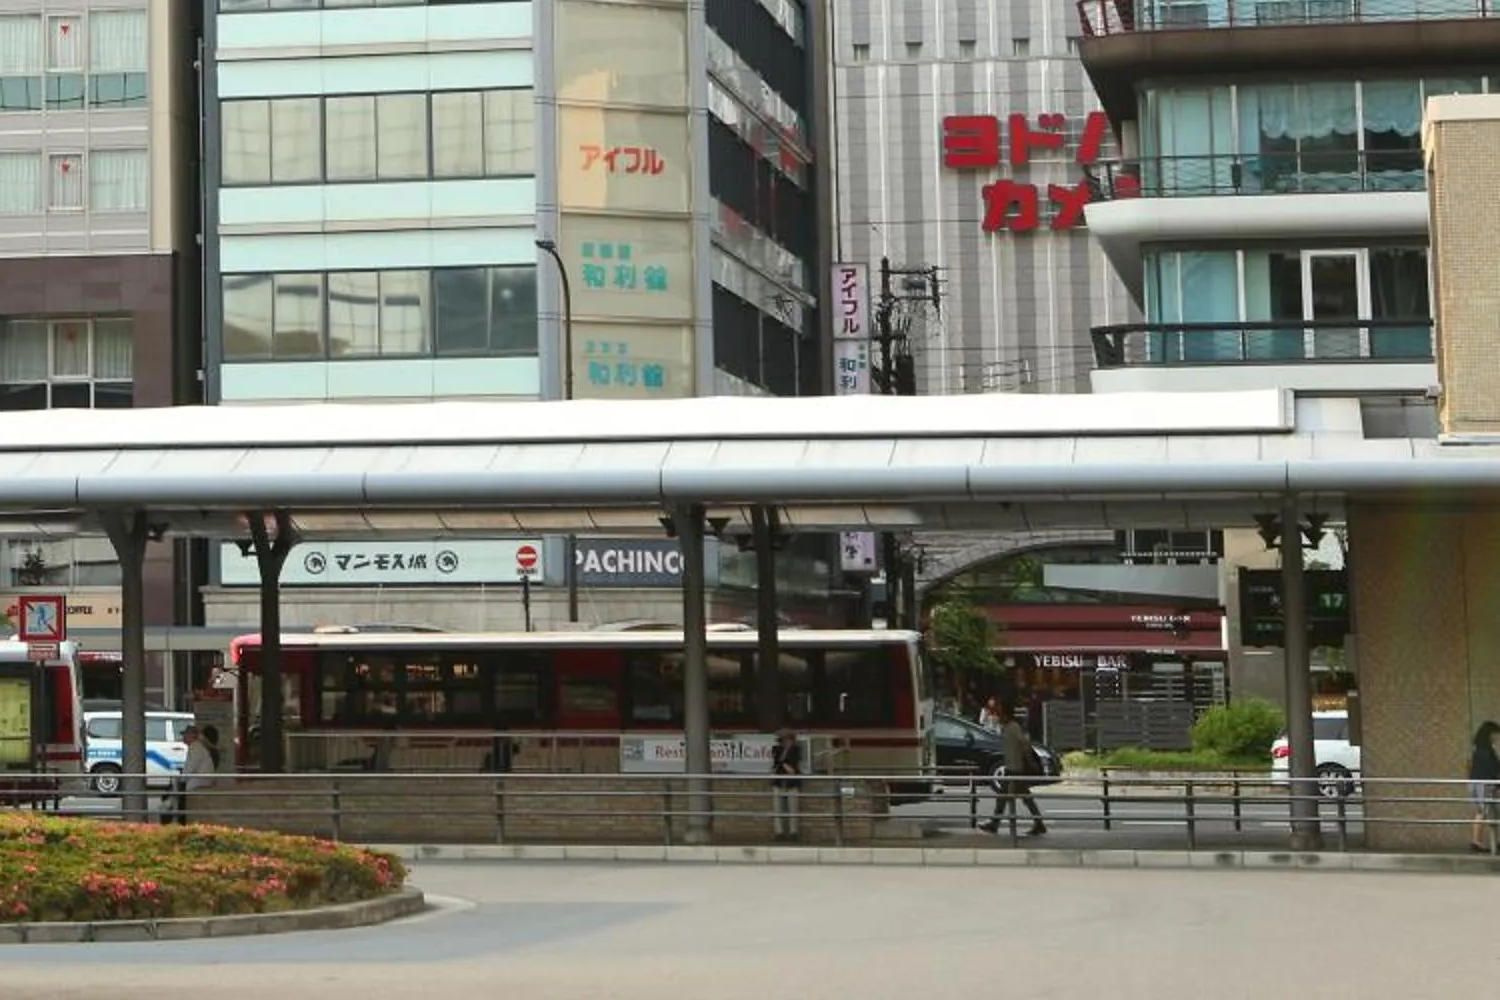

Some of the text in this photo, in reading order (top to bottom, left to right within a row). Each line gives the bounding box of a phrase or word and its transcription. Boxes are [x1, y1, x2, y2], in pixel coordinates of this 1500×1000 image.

[580, 146, 665, 176] アイフル
[840, 267, 860, 334] アイフル
[575, 549, 684, 574] PACHINC
[1034, 656, 1083, 667] YEBISU
